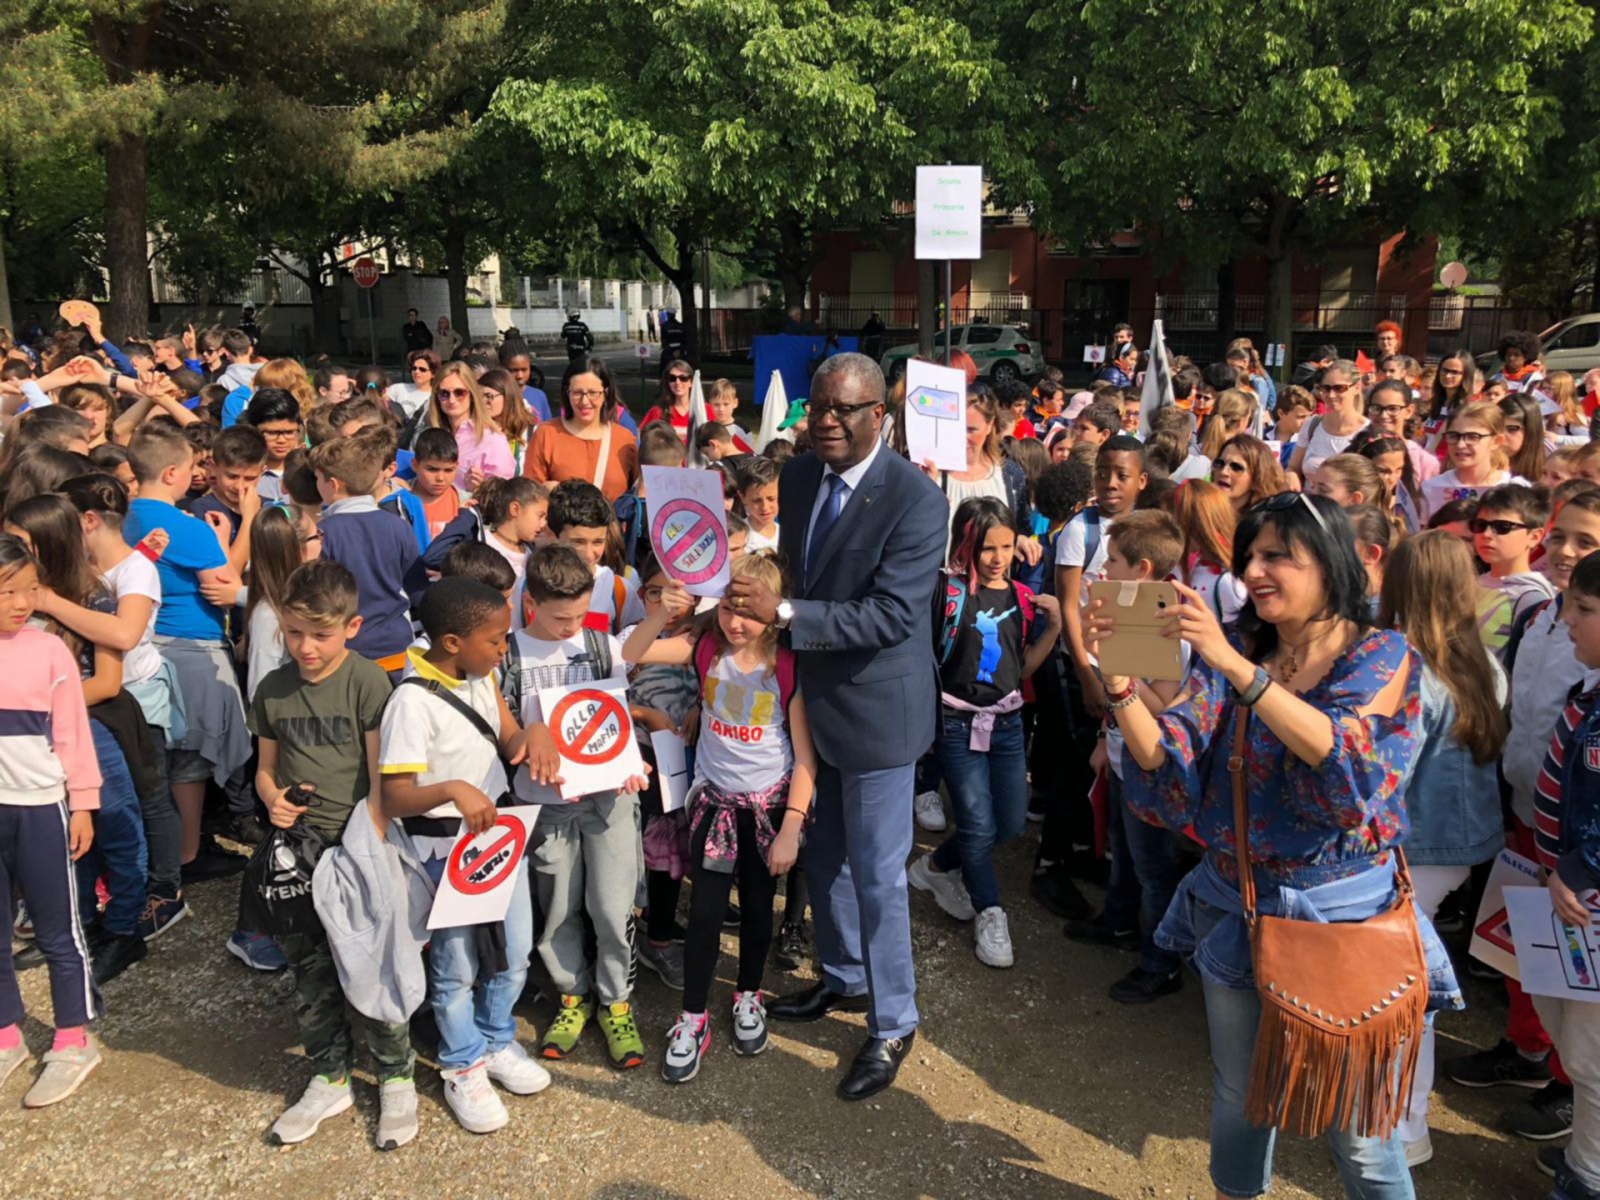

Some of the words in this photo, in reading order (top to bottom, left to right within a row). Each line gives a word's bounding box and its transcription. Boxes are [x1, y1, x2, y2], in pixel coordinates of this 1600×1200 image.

[355, 266, 376, 278] STOP
[566, 703, 598, 741] ALLA
[587, 723, 619, 754] MAFIA
